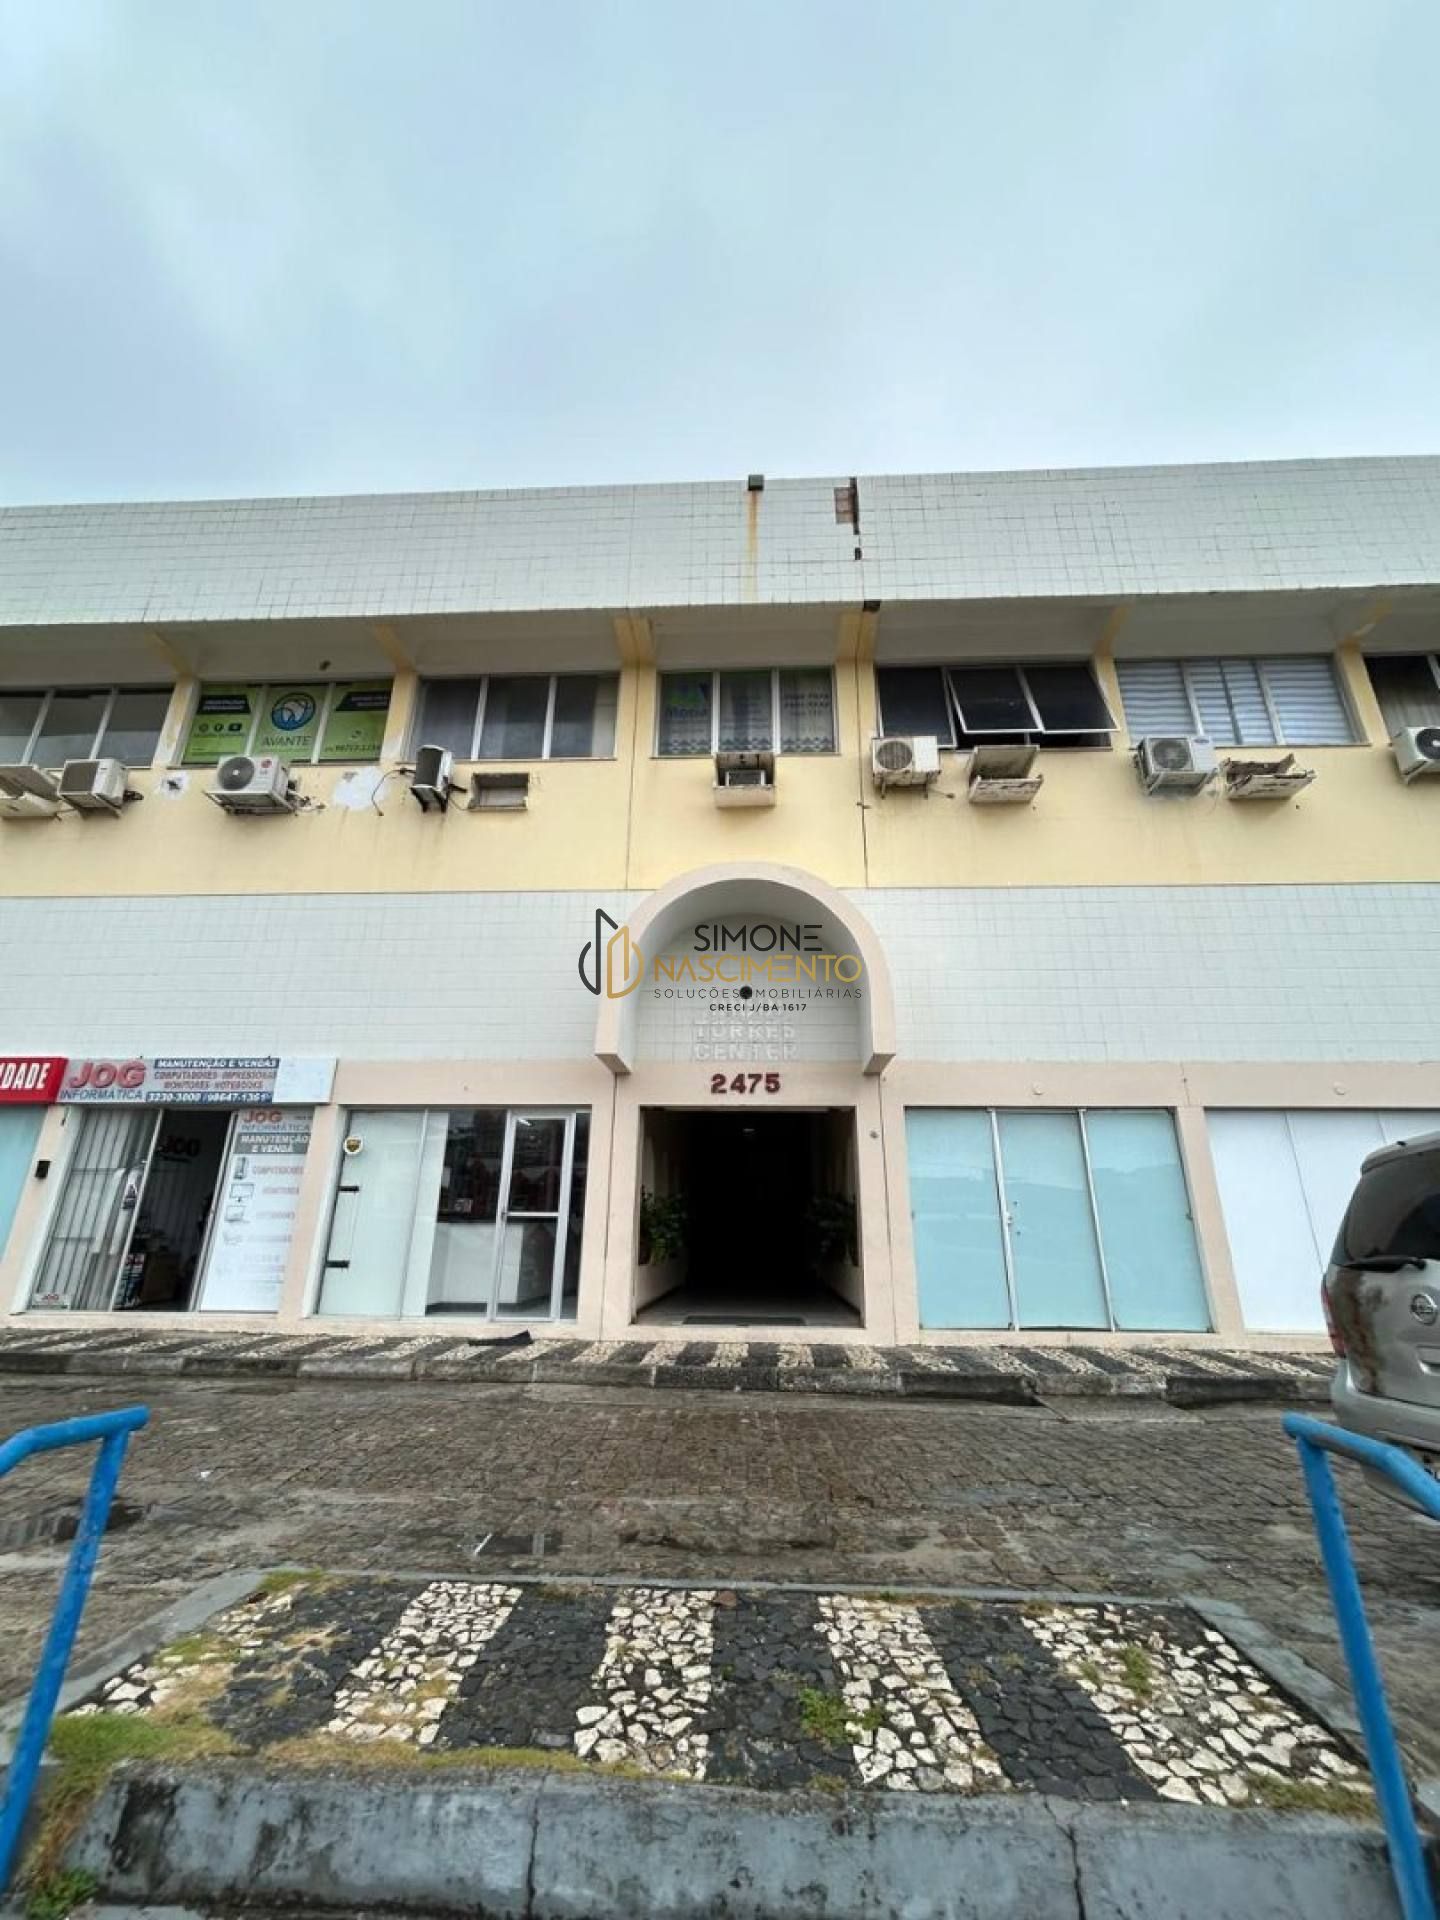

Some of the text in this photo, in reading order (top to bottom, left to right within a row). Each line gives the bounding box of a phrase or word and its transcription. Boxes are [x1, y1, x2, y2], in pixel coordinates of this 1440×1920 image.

[261, 735, 313, 746] AVANTE
[694, 1042, 800, 1061] CENTER
[157, 1059, 277, 1069] MANUTENÇÃO E VENDAS
[68, 1060, 147, 1088] JOG
[710, 1072, 782, 1095] 2475
[243, 1110, 283, 1123] JOG
